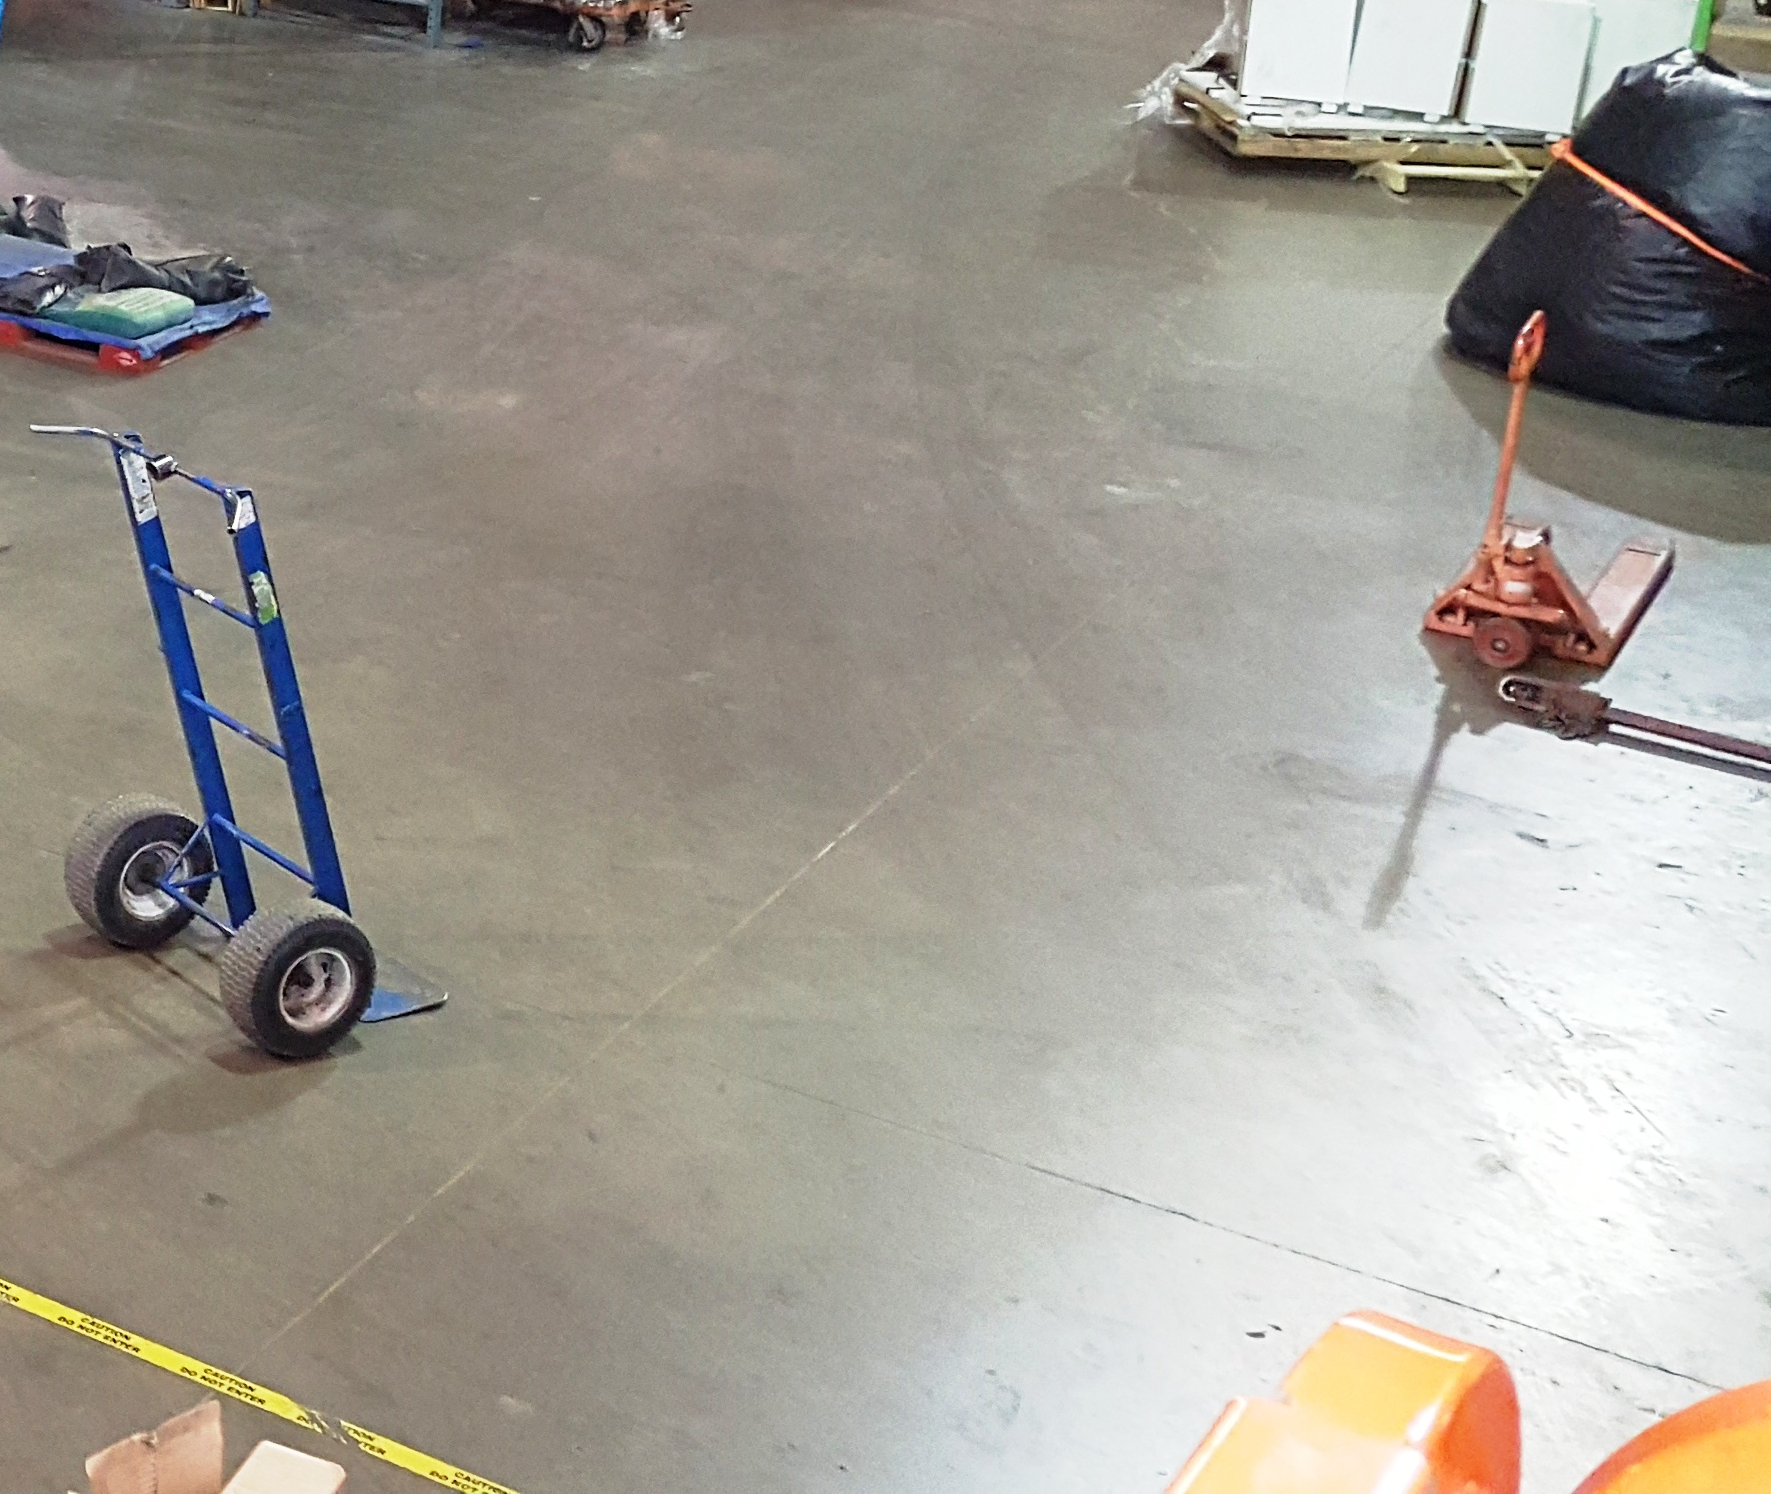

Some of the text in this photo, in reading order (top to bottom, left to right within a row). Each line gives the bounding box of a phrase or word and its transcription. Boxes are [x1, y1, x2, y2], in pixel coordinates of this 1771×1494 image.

[58, 1316, 140, 1353] DO NOT ENTER
[81, 1318, 131, 1340] CAUTION
[180, 1367, 265, 1405] DO NOT ENTER
[204, 1368, 256, 1392] CAUTION
[429, 1471, 448, 1481] DO
